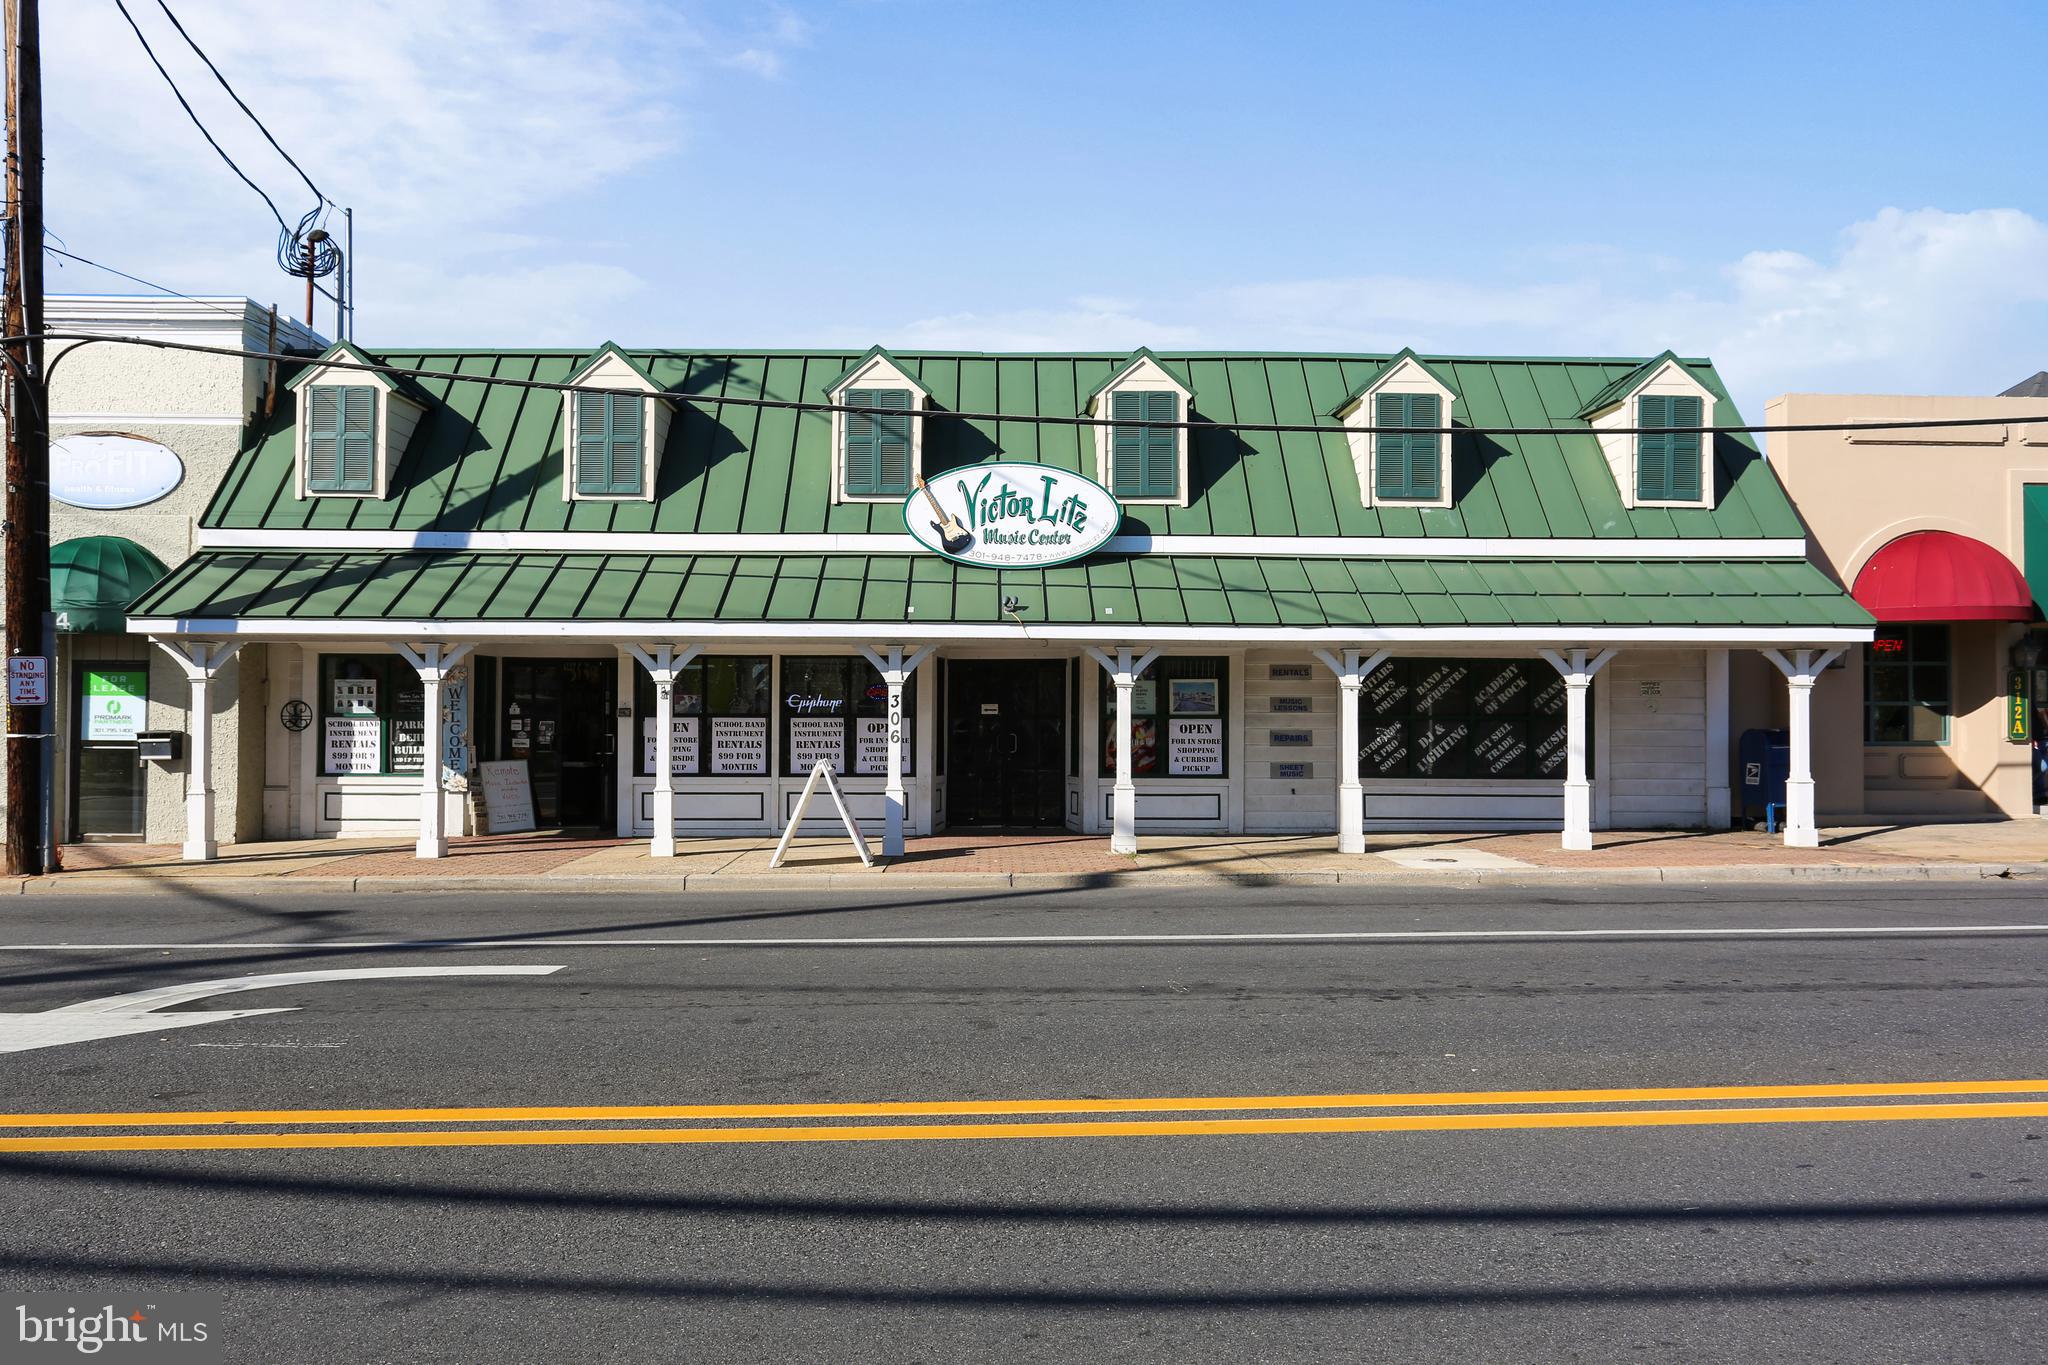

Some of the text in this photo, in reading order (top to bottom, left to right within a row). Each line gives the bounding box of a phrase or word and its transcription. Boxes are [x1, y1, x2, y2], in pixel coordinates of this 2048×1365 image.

[983, 528, 1072, 545] Music Center
[969, 550, 1042, 561] 301-948-7478
[20, 662, 34, 670] NO
[1371, 678, 1396, 702] AMPS
[1416, 665, 1450, 696] BAND &
[1416, 667, 1468, 712] ORCHESTRA
[1474, 664, 1519, 706] ACADEMY
[786, 693, 843, 713] Epiphone
[1375, 685, 1408, 714] DRUMS
[1484, 676, 1528, 714] OF ROCK
[396, 720, 424, 729] PARK
[448, 687, 464, 771] WELCOME
[1180, 724, 1213, 734] OPEN
[1418, 723, 1446, 749] DJ &
[331, 740, 376, 748] RENTALS
[399, 733, 424, 741] BEHI
[717, 740, 762, 748] RENTALS
[796, 740, 841, 748] RENTALS
[1416, 724, 1468, 772] LIGHTING
[1474, 722, 1513, 756] BUY SELL
[1485, 735, 1516, 761] TRADE
[1536, 724, 1568, 757] MUSIC
[332, 752, 348, 760] $99
[394, 746, 424, 754] BUILD
[718, 752, 734, 760] $99
[797, 752, 813, 760] $99
[1373, 739, 1399, 762] & PRO
[1380, 747, 1408, 772] SOUND
[1490, 741, 1527, 773] CONSIGN
